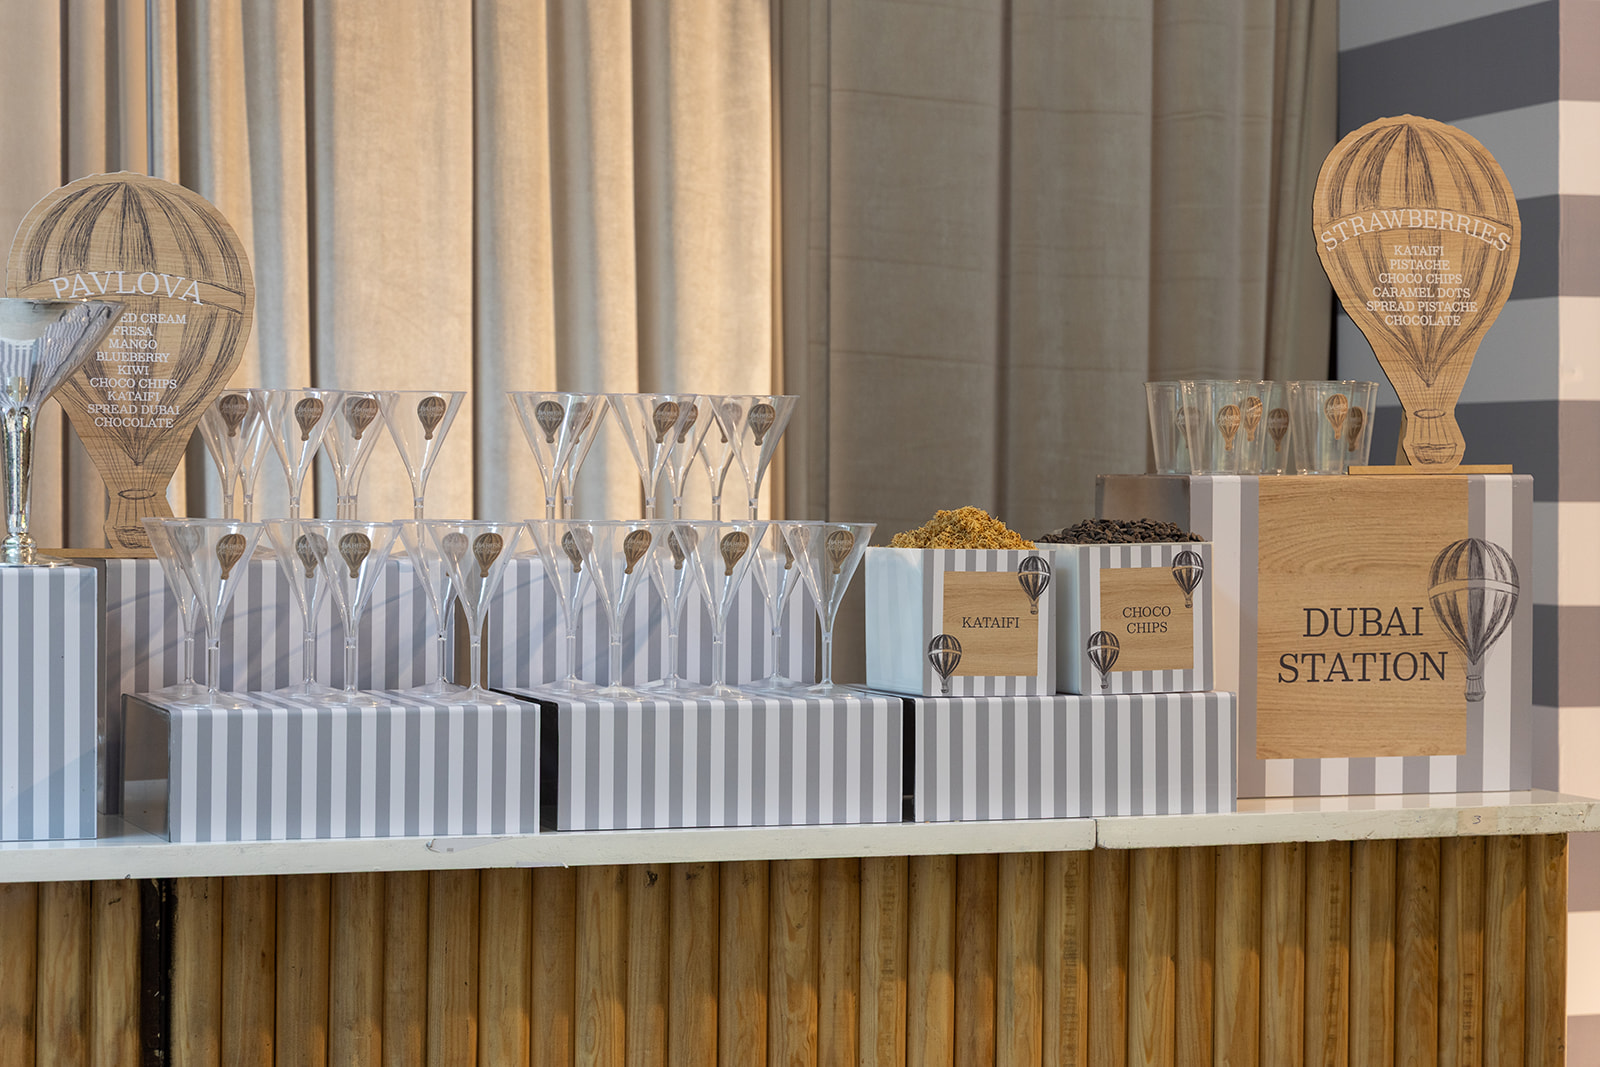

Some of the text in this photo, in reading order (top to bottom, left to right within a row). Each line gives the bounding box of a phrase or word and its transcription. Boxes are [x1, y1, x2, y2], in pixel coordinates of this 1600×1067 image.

[1321, 209, 1511, 252] STRAWBERRIES
[1394, 245, 1445, 256] KATAIFI
[1390, 259, 1450, 271] PISTACHE
[1379, 273, 1463, 285] CHOCO CHIPS
[50, 271, 203, 305] PAVLOVA
[1372, 287, 1471, 298] CARAMEL DOTS
[1366, 301, 1478, 312] SPREAD PISTACHE
[140, 313, 187, 325] CREAM
[1385, 315, 1461, 326] CHOCOLATE
[112, 326, 154, 337] FRESA
[109, 339, 158, 350] MANGO
[96, 351, 170, 363] BLUEBERRY
[117, 365, 150, 376] KIWI
[90, 378, 177, 390] CHOCO CHIPS
[108, 391, 160, 402] KATAIFI
[87, 403, 180, 416] SPREAD DUBAI
[95, 417, 174, 428] CHOCOLATE
[1122, 605, 1172, 619] CHOCO
[962, 616, 1020, 629] KATAIFI
[1126, 621, 1168, 634] CHIPS
[1302, 606, 1424, 637] DUBAI
[1278, 651, 1449, 684] STATION
